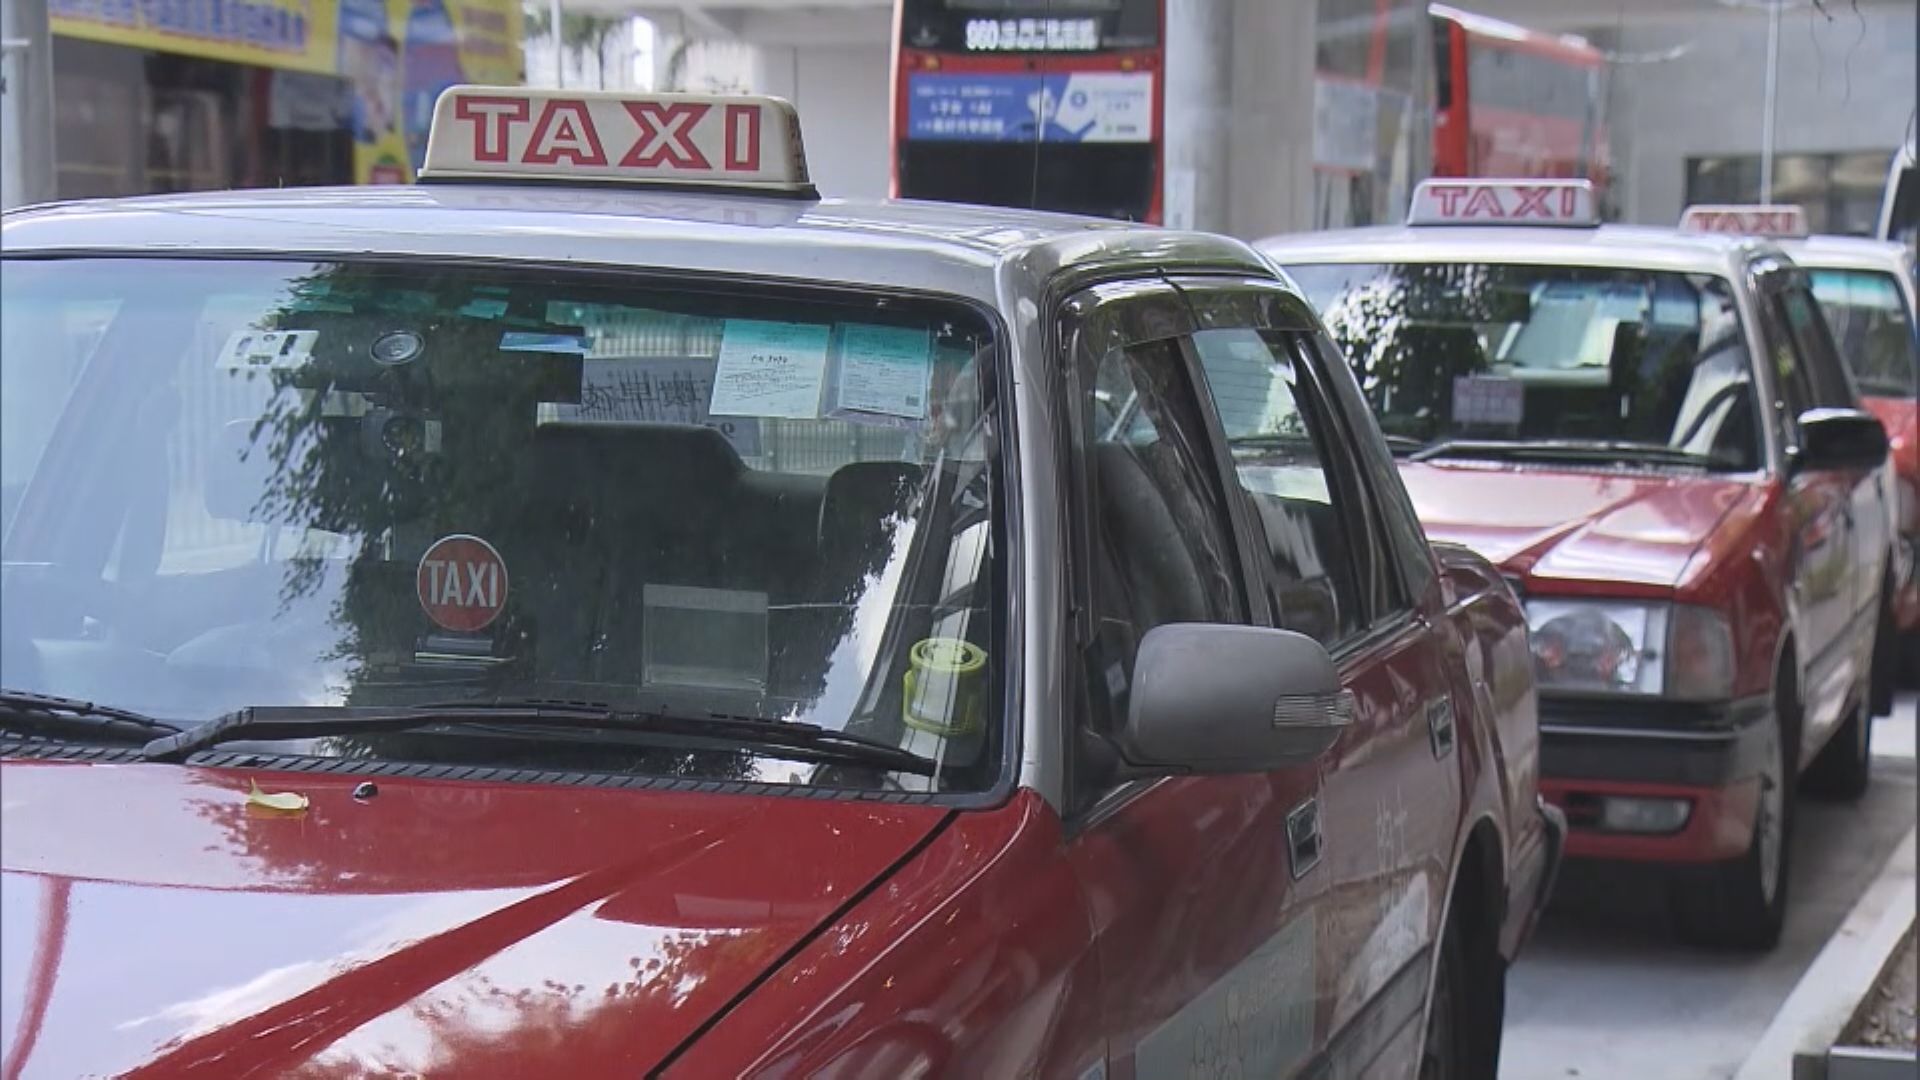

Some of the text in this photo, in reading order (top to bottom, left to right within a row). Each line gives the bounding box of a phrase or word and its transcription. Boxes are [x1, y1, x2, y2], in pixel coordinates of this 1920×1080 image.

[455, 94, 762, 171] TAXI
[1430, 186, 1577, 218] TAXI
[1691, 212, 1797, 234] TAXI
[425, 559, 498, 608] TAXI
